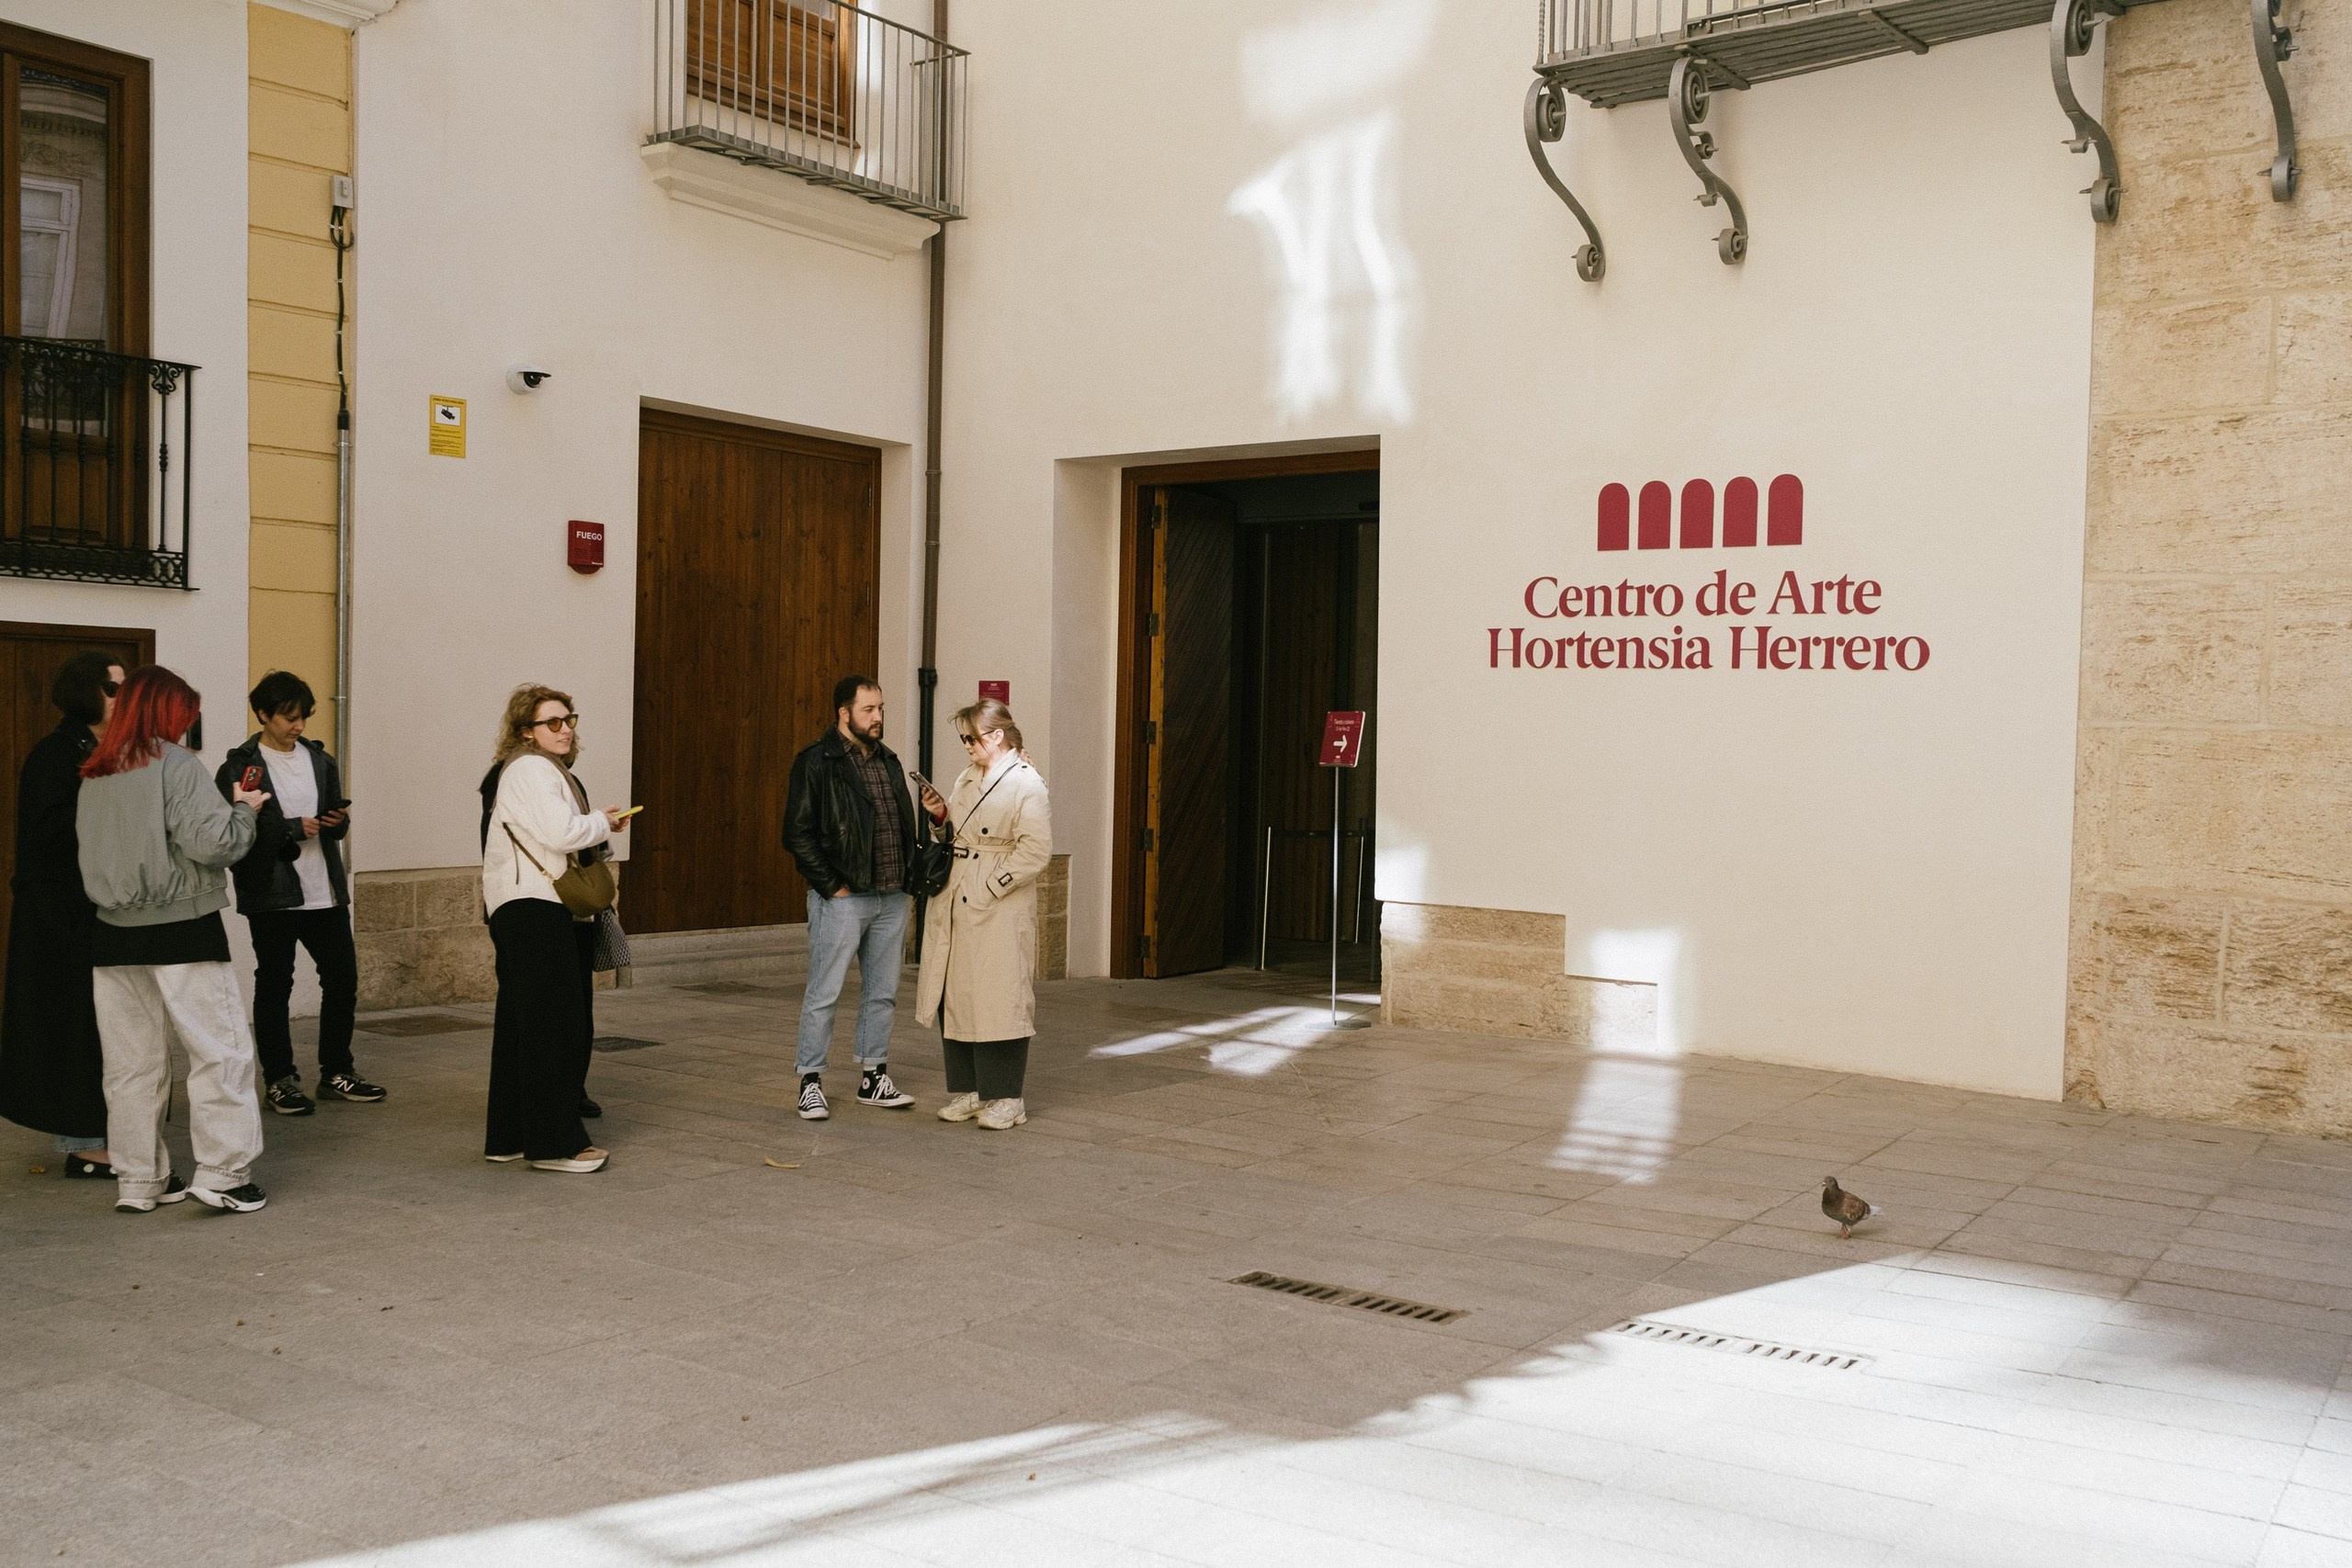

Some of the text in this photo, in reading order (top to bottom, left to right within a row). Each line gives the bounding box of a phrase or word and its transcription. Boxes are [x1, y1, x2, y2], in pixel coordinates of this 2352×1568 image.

[576, 530, 603, 541] FUEGO
[1524, 569, 1883, 618] Centro de Arte
[1487, 626, 1931, 671] Hortensia Herrero
